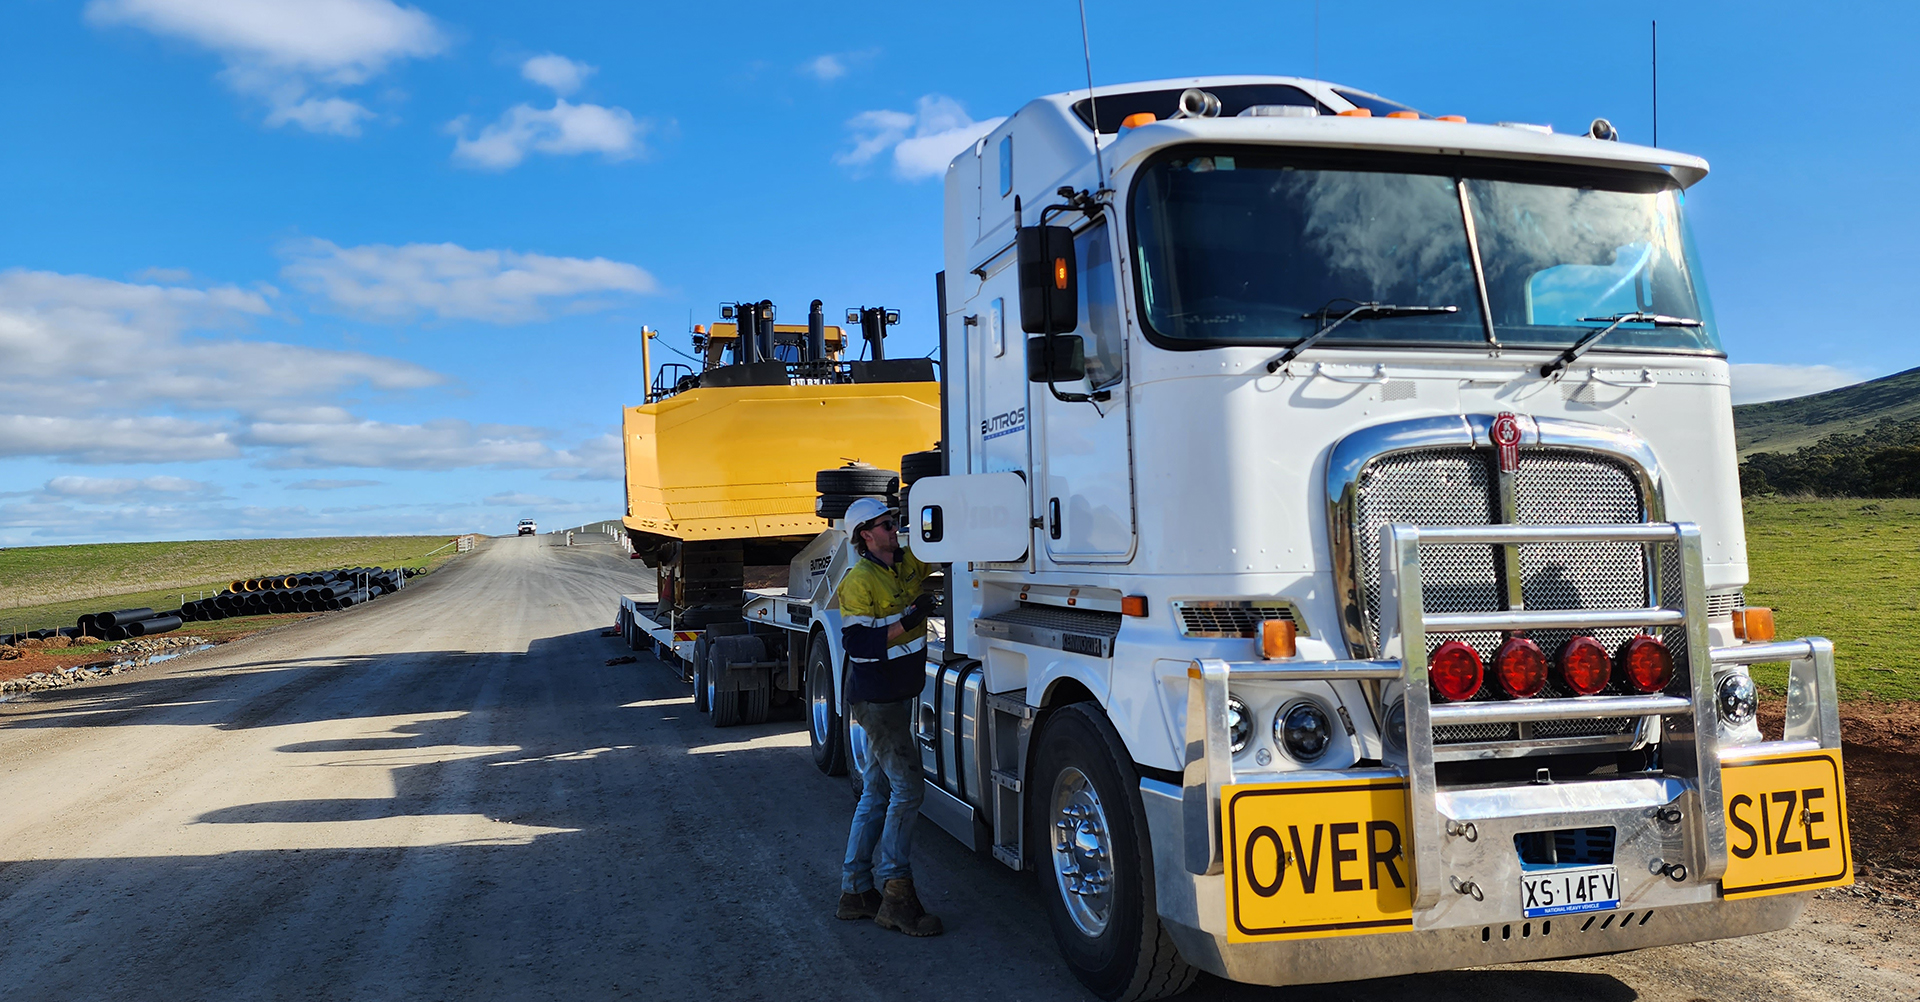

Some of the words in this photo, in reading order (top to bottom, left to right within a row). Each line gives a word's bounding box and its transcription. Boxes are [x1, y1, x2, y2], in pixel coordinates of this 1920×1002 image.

[980, 407, 1025, 435] BUTTROS
[1728, 787, 1831, 860] SIZE
[1244, 819, 1406, 898] OVER
[1581, 902, 1600, 910] VEHICLE
